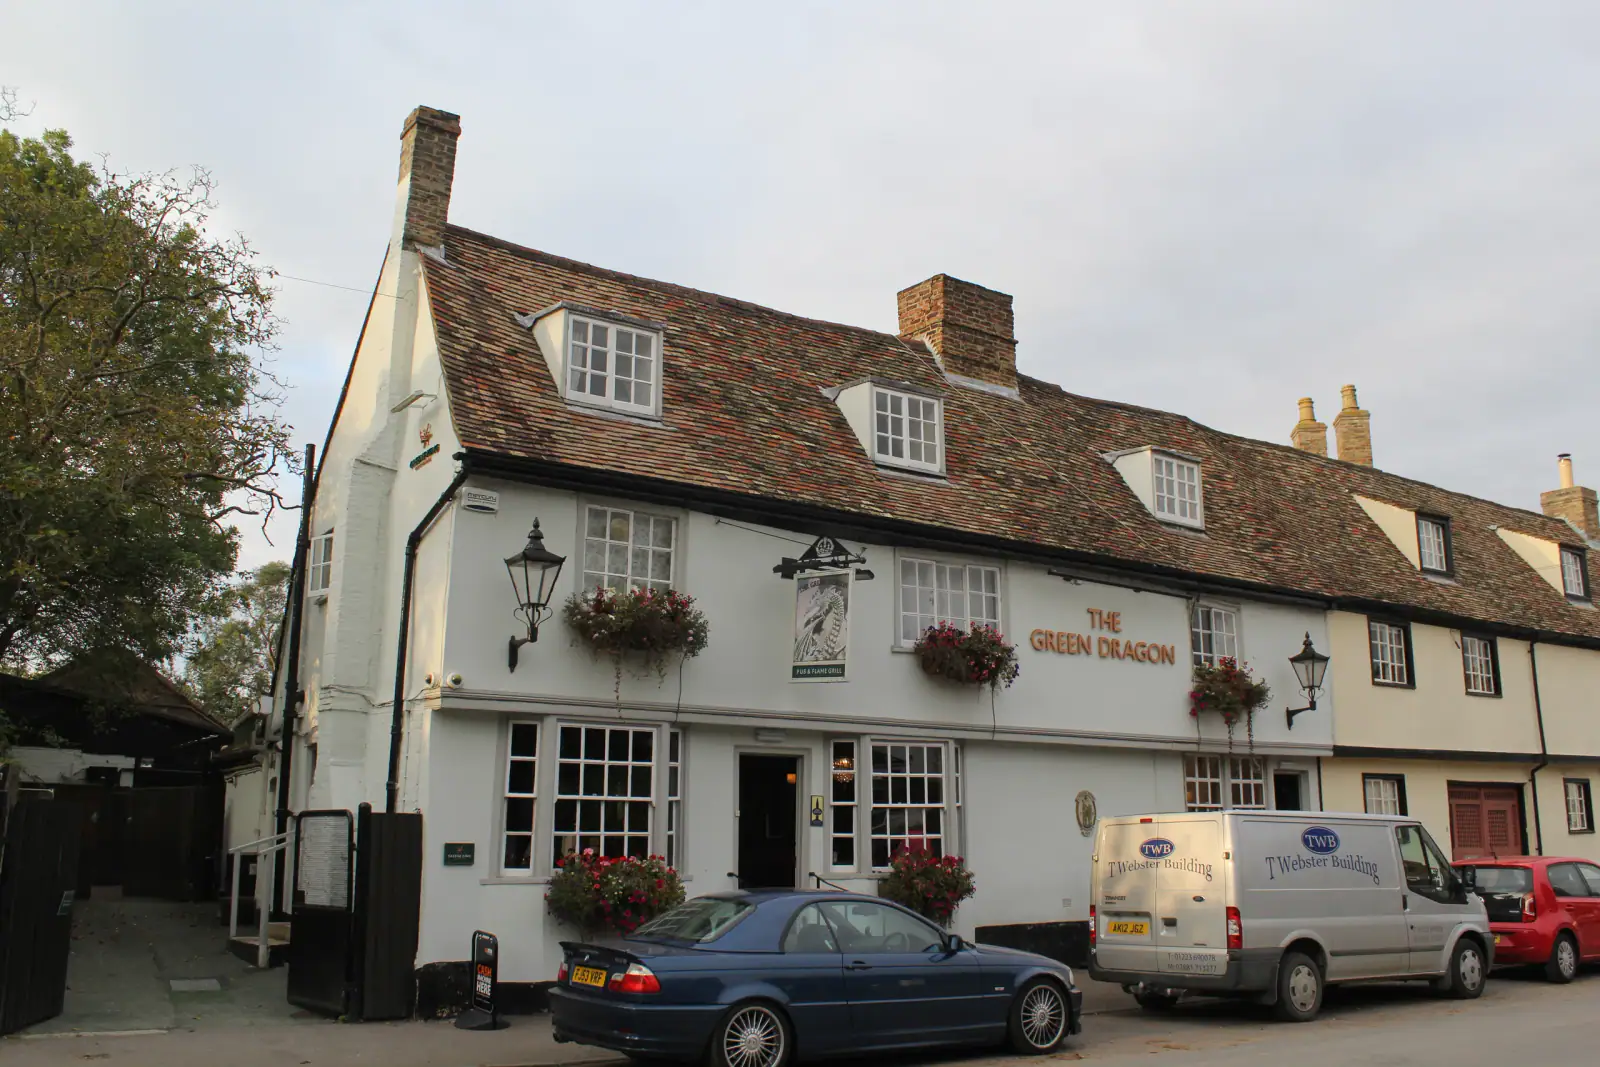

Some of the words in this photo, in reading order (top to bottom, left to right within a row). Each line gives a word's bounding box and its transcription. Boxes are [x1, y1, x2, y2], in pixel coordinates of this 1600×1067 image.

[1087, 607, 1122, 633] THE
[1030, 628, 1093, 656] GREEN
[1097, 636, 1176, 666] DRAGON
[1304, 834, 1337, 848] TWB
[1142, 843, 1172, 855] TWB
[1108, 861, 1117, 878] T
[1117, 859, 1161, 875] Webster
[1164, 858, 1213, 882] Building
[1265, 856, 1275, 880] T
[1276, 854, 1329, 875] Webster
[1331, 854, 1380, 886] Building
[1112, 923, 1129, 933] AK12
[1129, 923, 1144, 934] JGZ
[477, 963, 493, 977] CASH
[575, 967, 590, 982] FJ53
[476, 980, 491, 996] HERE
